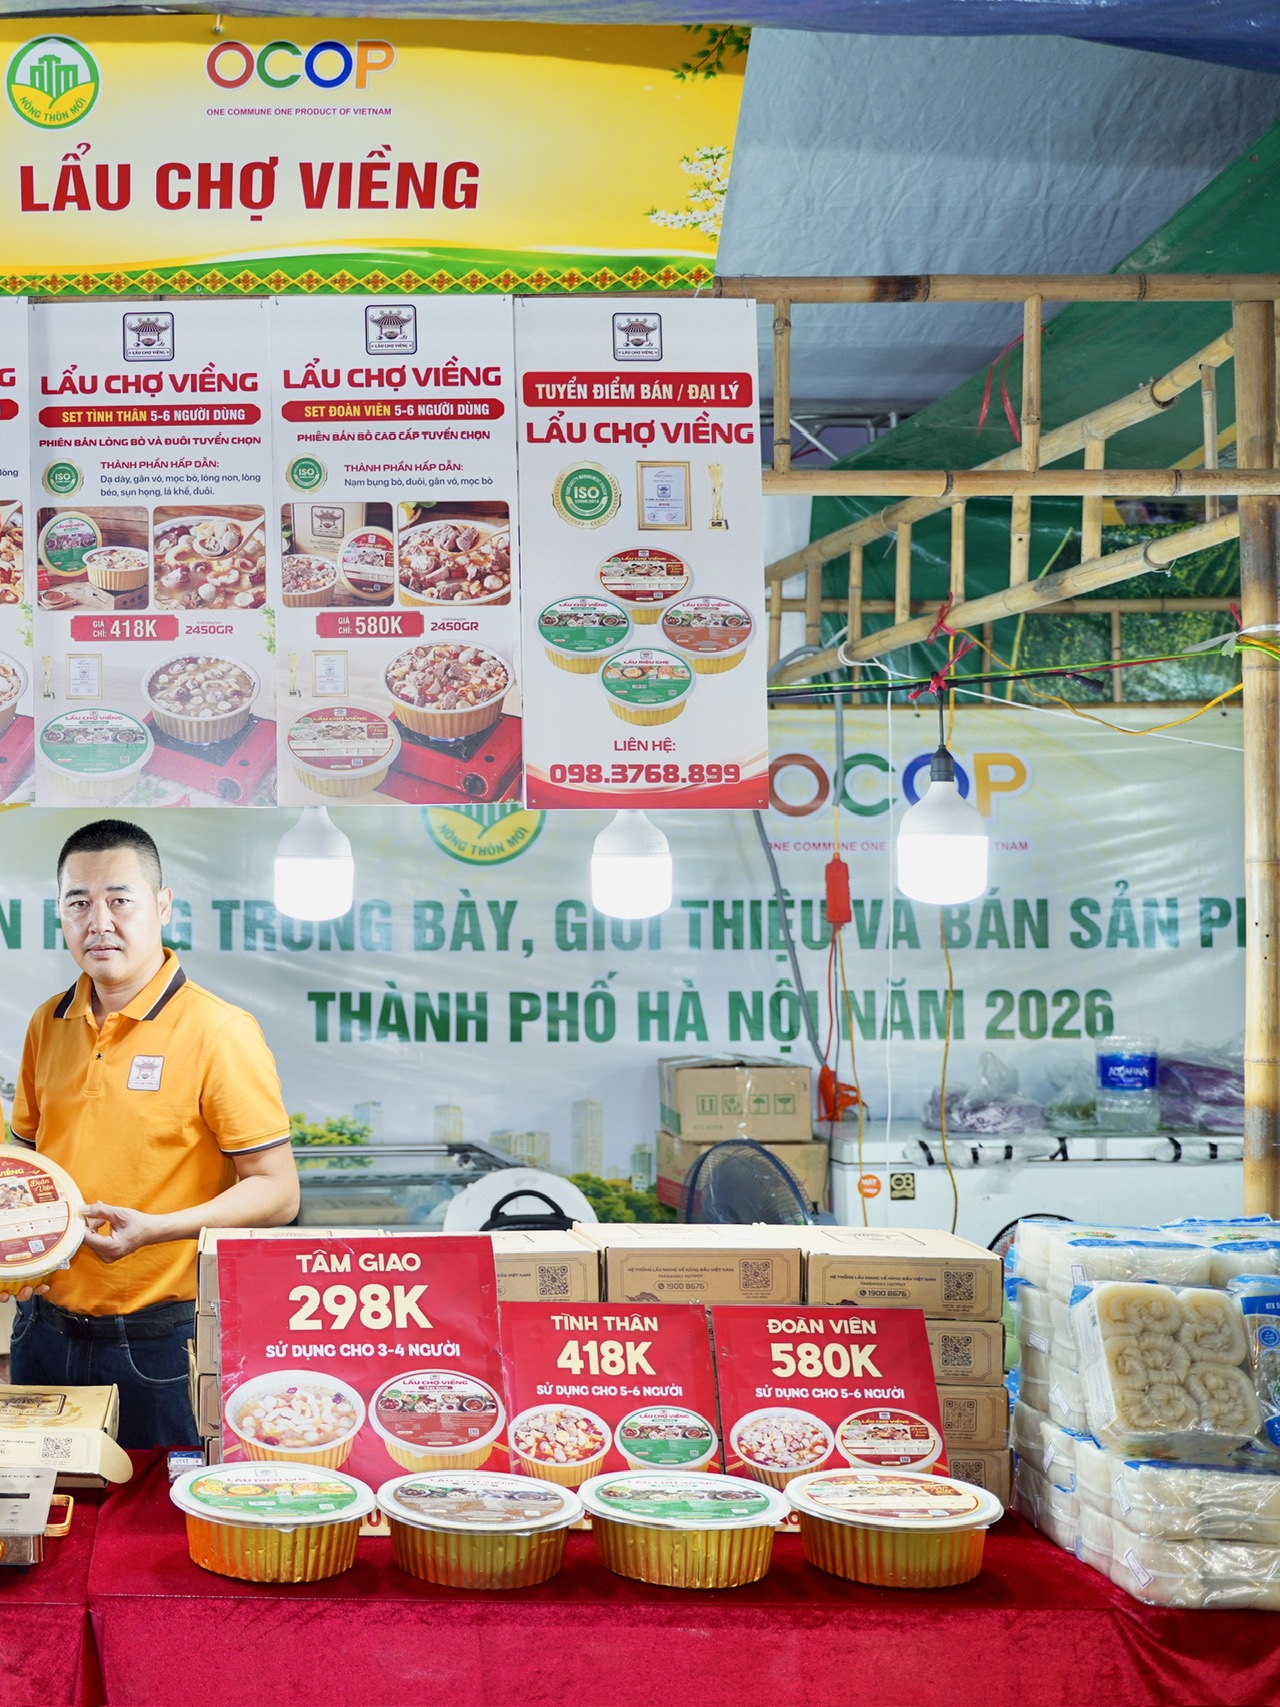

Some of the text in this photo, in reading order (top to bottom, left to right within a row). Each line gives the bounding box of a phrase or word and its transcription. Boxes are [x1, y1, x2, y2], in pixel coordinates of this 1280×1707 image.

[206, 40, 396, 90] OCOP
[19, 96, 87, 122] NÔNG THÔN MỚI
[206, 108, 225, 116] ONE
[227, 108, 272, 116] COMMUNE
[274, 108, 292, 116] ONE
[295, 108, 337, 116] PRODUCT
[20, 142, 479, 221] LẨU CHỢ VIỀNG
[535, 376, 739, 403] TUYỂN ĐIỂM BÁN / ĐẠI LÝ
[62, 407, 245, 423] SET TÌNH THÂN 5-6 NGƯỜI DÙNG
[526, 410, 754, 449] LẨU CHỢ VIỀNG
[298, 468, 315, 478] ISO
[573, 486, 600, 499] ISO
[110, 620, 158, 638] 418K
[185, 625, 234, 635] 2450GR
[355, 616, 403, 635] 580K
[430, 621, 479, 632] 2450GR
[614, 737, 676, 753] LIÊN HỆ:
[549, 764, 741, 784] 098.3768.899
[941, 886, 1050, 949] BÁN
[1069, 879, 1180, 949] SẢN
[307, 980, 488, 1043] THÀNH
[509, 971, 618, 1043] PHỐ
[637, 979, 710, 1043] HÀ
[840, 977, 965, 1041] NĂM
[985, 988, 1115, 1041] 2026
[296, 1249, 422, 1273] TÂM GIAO
[287, 1283, 434, 1331] 298K
[550, 1313, 658, 1331] TÌNH THÂN
[766, 1316, 877, 1334] ĐOÀN VIÊN
[266, 1340, 461, 1361] SỬ DỤNG CHO 3-4 NGƯỜI
[557, 1339, 656, 1377] 418K
[770, 1342, 884, 1379] 580K
